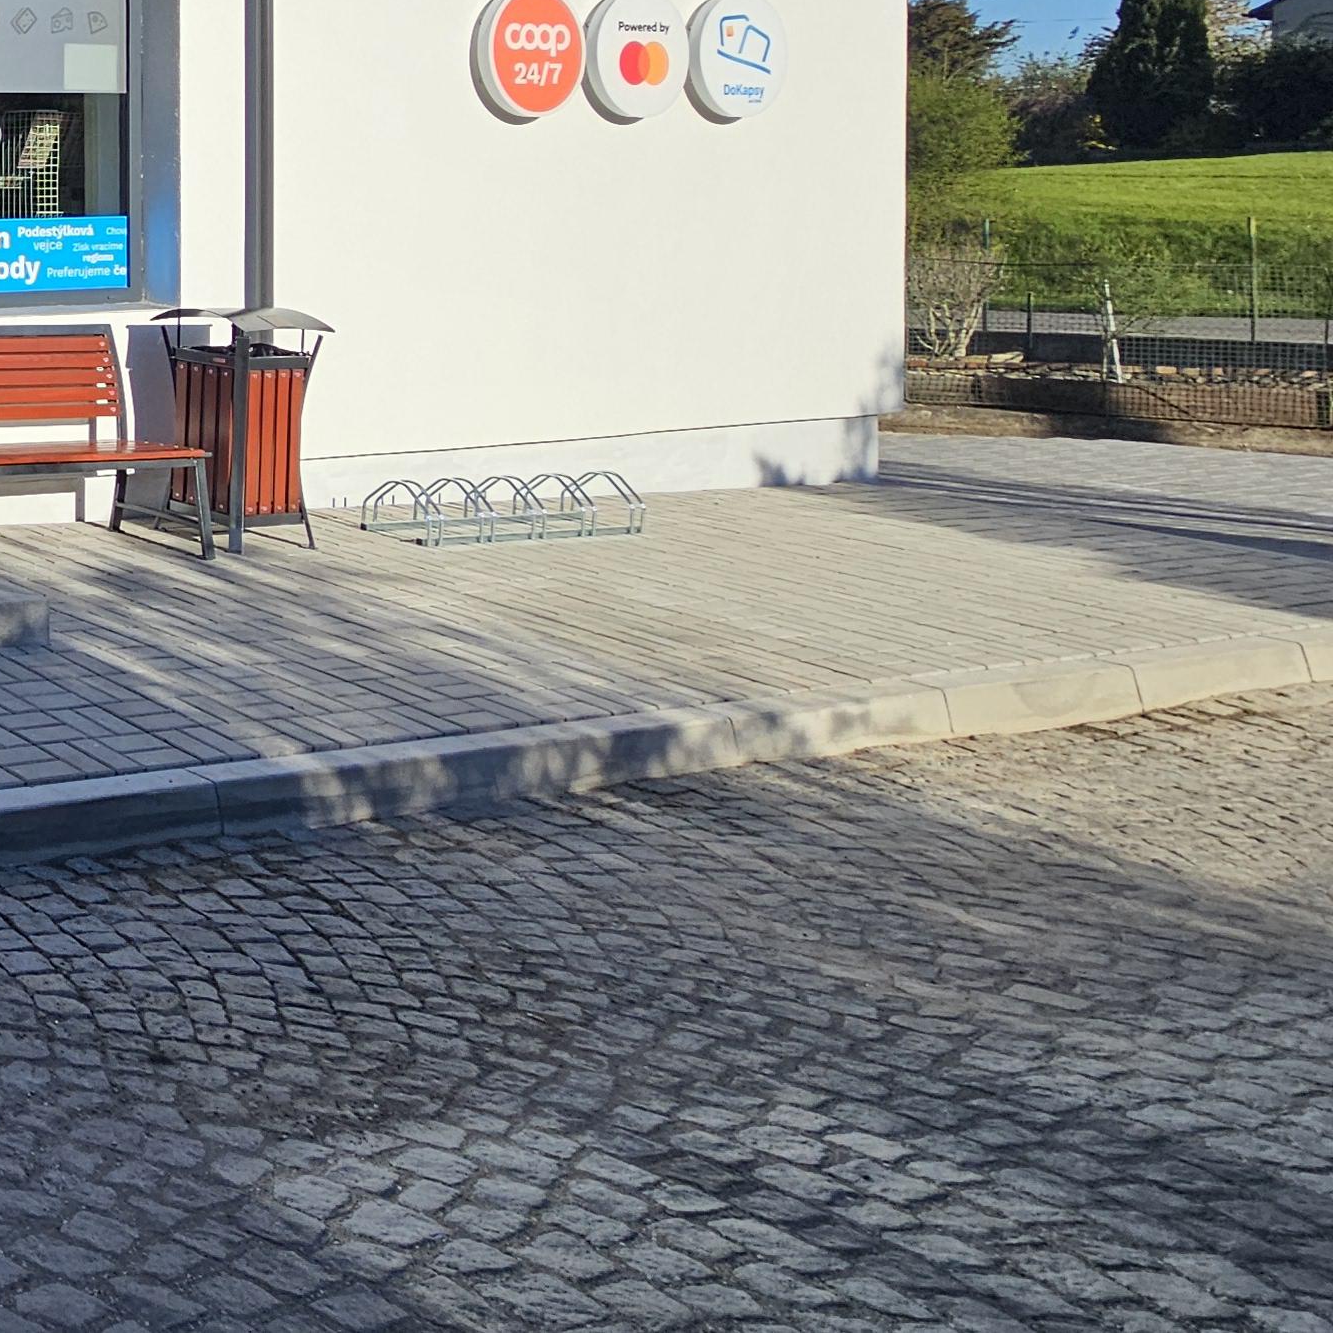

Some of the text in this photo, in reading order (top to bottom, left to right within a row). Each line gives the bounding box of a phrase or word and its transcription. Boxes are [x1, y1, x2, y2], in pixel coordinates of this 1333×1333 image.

[618, 21, 670, 34] Powered by
[504, 22, 572, 57] coop
[513, 61, 563, 86] 24/7
[723, 83, 765, 99] DoKapsy
[17, 224, 95, 239] Podestýlková
[33, 241, 63, 253] vejce
[72, 243, 90, 252] Zisk
[46, 266, 111, 279] Preferujeme
